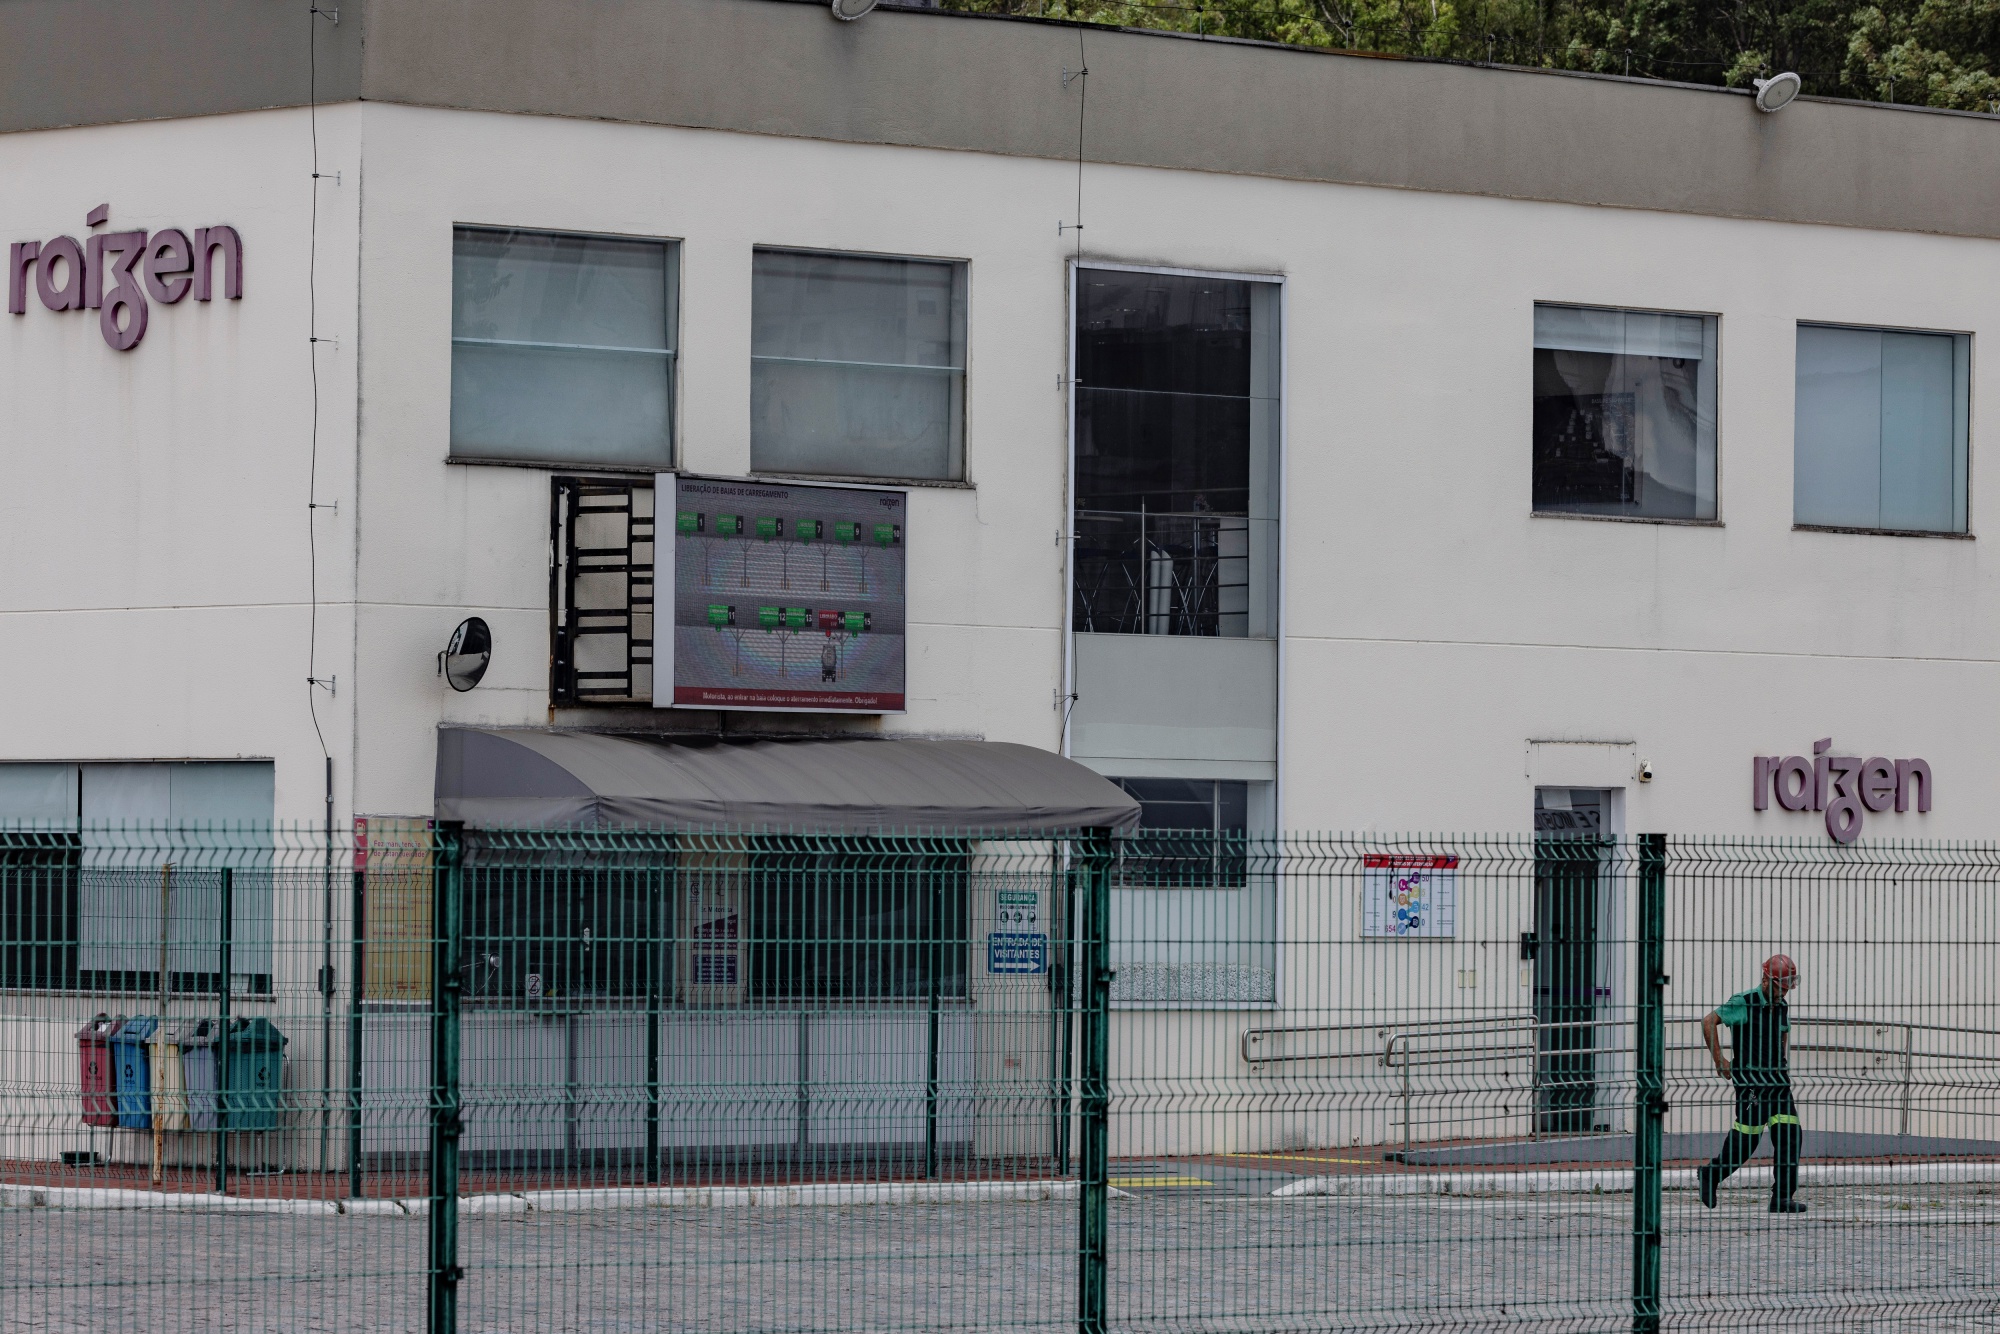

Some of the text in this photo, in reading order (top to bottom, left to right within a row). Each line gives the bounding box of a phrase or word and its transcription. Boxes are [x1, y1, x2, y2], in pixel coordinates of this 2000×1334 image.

[9, 203, 243, 350] raízen
[681, 484, 711, 494] LIBERAÇÃO
[746, 489, 788, 498] CARREGAMENTO
[700, 518, 703, 526] 1
[738, 520, 742, 528] 3
[817, 526, 821, 534] 7
[856, 528, 860, 536] 9
[729, 612, 735, 620] 11
[780, 613, 786, 621] 12
[1754, 738, 1932, 844] raízen
[994, 950, 1040, 958] VISITANTES
